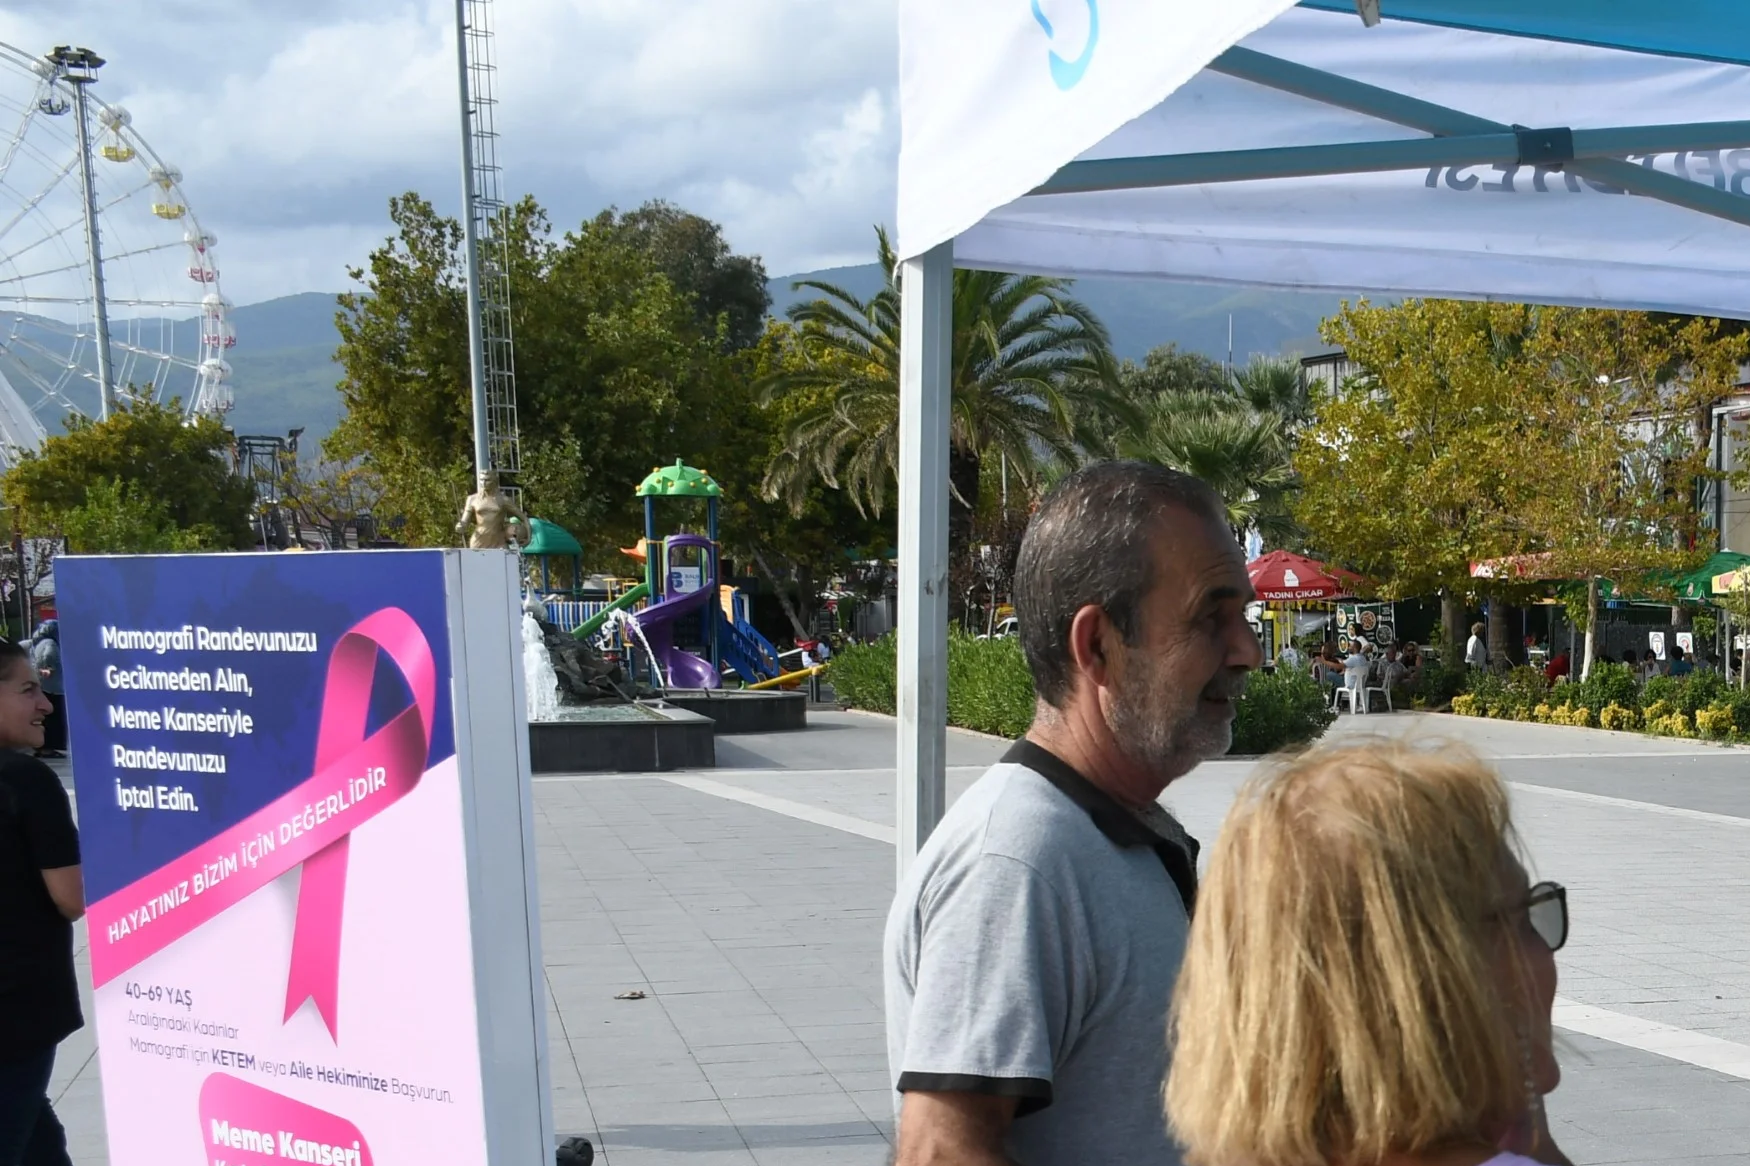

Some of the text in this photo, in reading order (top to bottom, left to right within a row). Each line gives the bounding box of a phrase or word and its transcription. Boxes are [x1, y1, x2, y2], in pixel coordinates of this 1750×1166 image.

[1263, 588, 1324, 600] TADINI ÇIKAR
[102, 625, 317, 654] Mamografi Randevunuzu
[106, 665, 253, 697] Gecikmeden Alın,
[109, 705, 253, 737] Meme Kanseriyle
[113, 745, 226, 773] Randevunuzu
[116, 778, 199, 812] İptal Edin.
[108, 766, 387, 944] HAYATINIZ BİZİM İÇİN DEĞERLİDİR
[165, 986, 193, 1012] YAŞ
[128, 1010, 239, 1040] Aralığındaki Kadınlar
[129, 1036, 454, 1104] Mamografi için KETEM veya Aile Hekiminize Başvurun.
[211, 1118, 275, 1156] Meme
